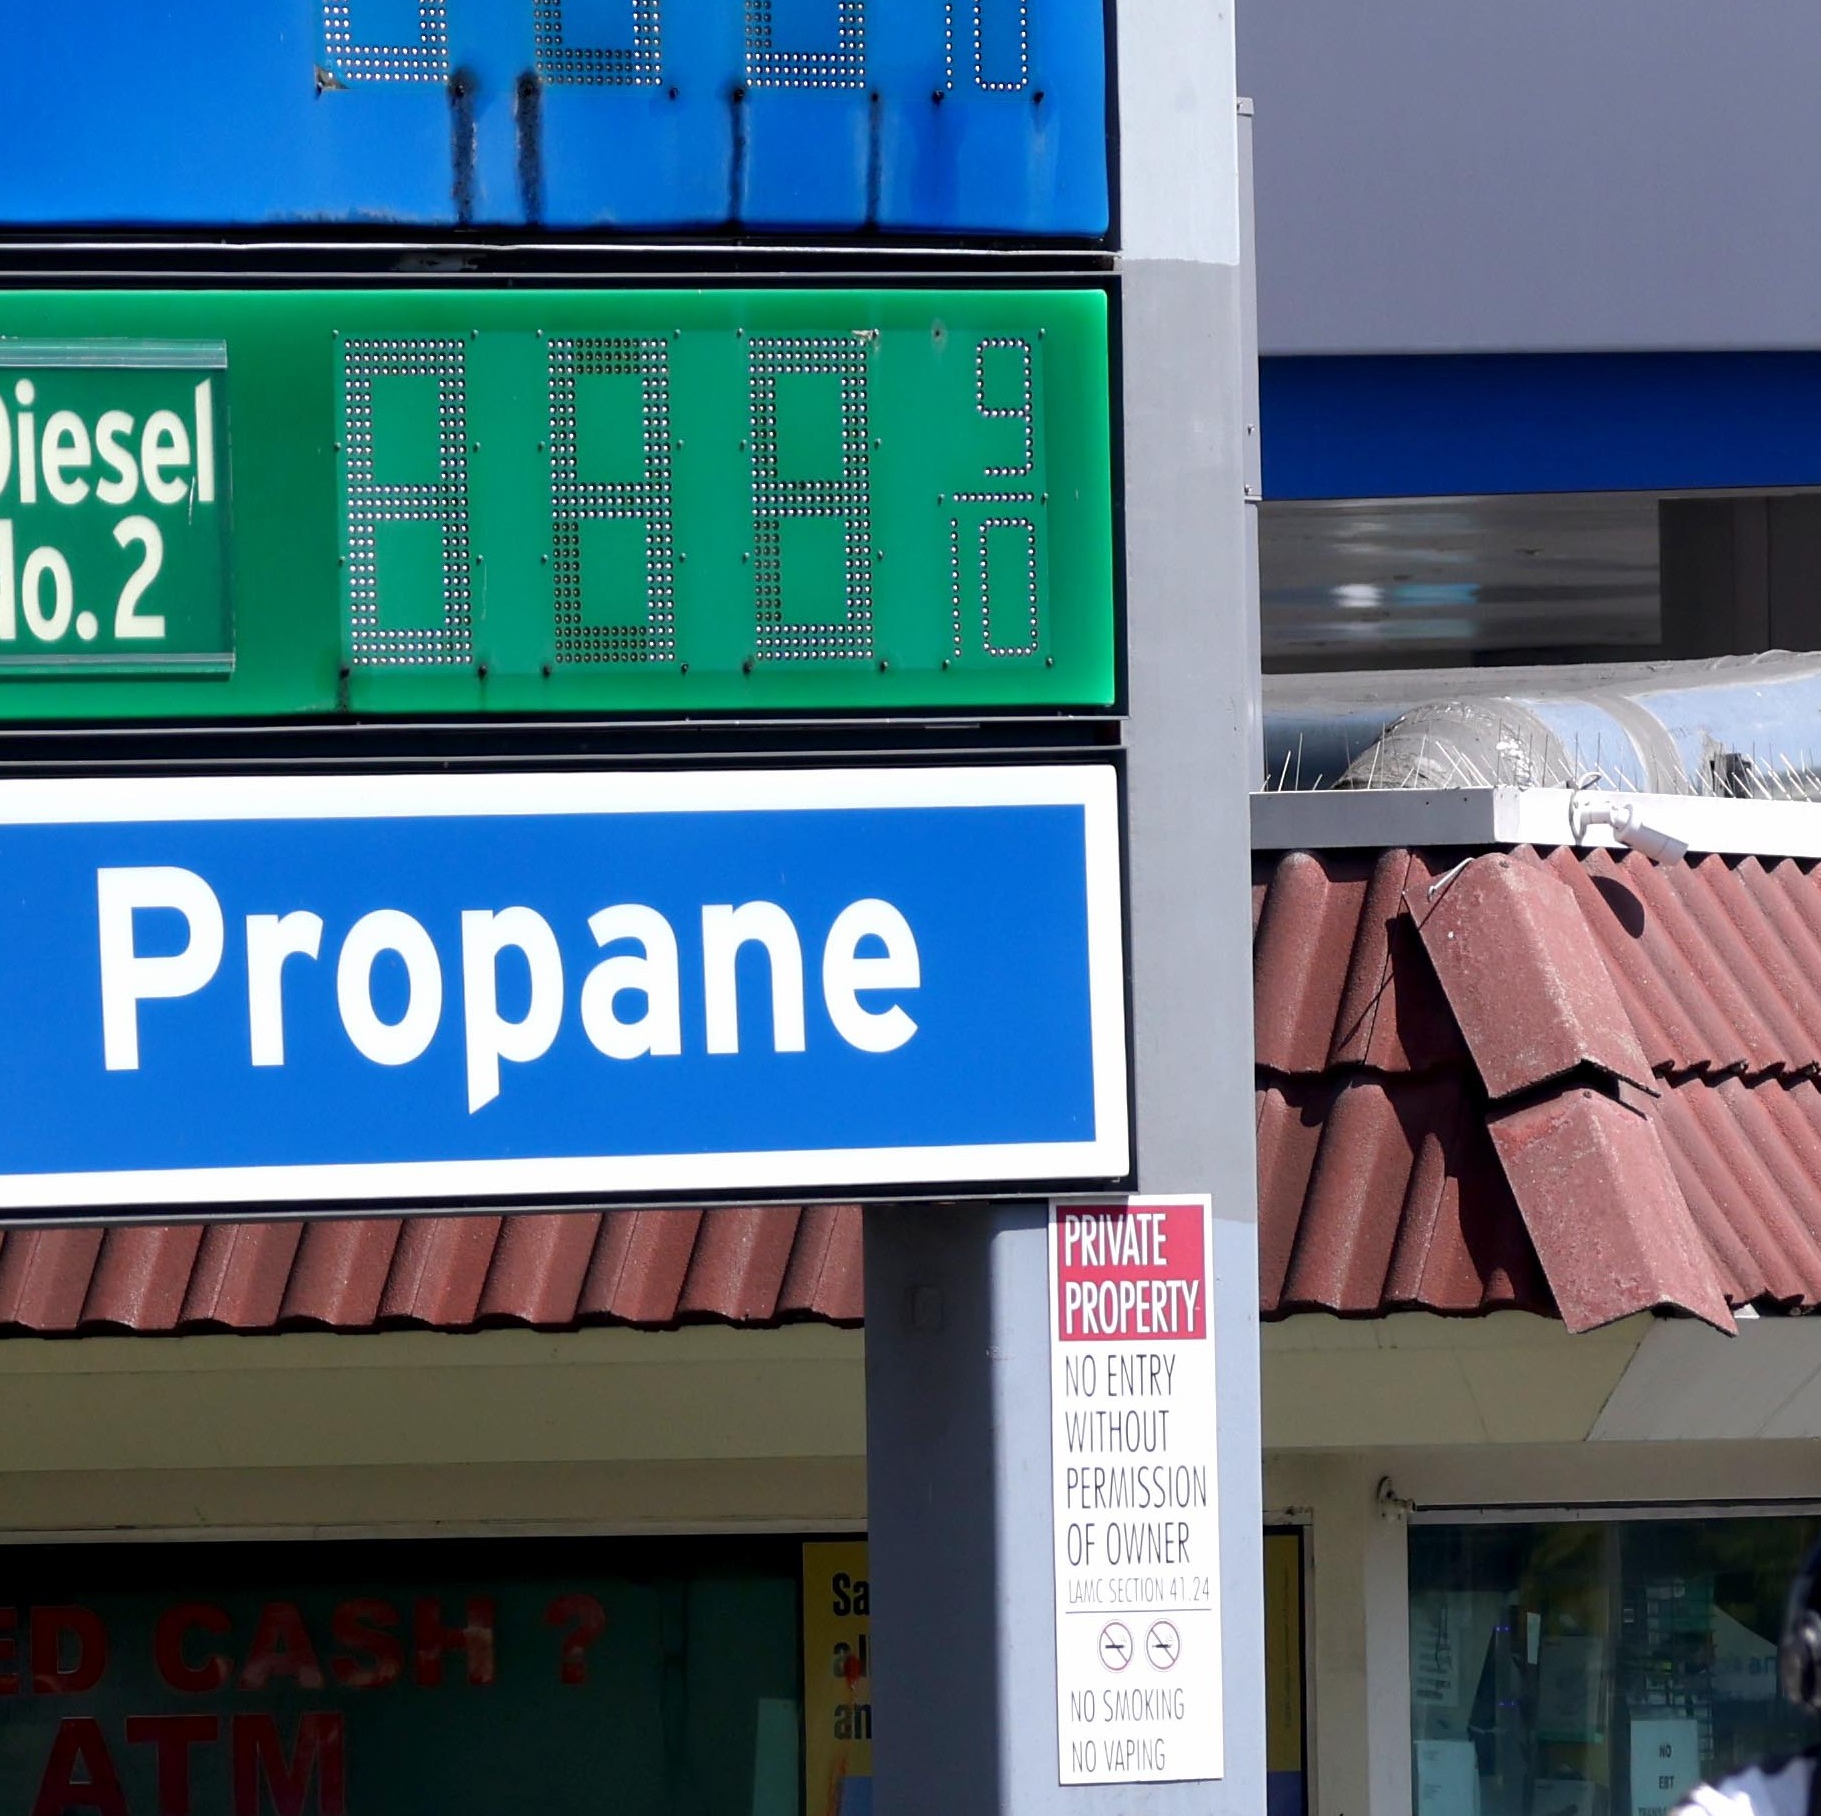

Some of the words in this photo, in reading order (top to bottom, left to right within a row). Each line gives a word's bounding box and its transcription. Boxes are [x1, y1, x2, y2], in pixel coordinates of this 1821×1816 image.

[112, 514, 166, 639] 2
[96, 866, 923, 1118] Propane
[1064, 1211, 1168, 1267] PRIVATE
[1064, 1279, 1200, 1337] PROPERTY
[1065, 1354, 1097, 1399] NO
[1108, 1352, 1177, 1398] ENTRY
[1065, 1409, 1169, 1455] WITHOUT
[1066, 1464, 1208, 1511] PERMISSION
[1067, 1522, 1095, 1567] OF
[1107, 1521, 1191, 1565] OWNER
[1069, 1578, 1104, 1604] LAMC
[1108, 1577, 1164, 1603] SECTION
[1169, 1576, 1210, 1602] 41.24
[153, 1595, 500, 1693] CASH
[542, 1592, 608, 1687] ?
[1071, 1688, 1096, 1723] NO
[1104, 1687, 1185, 1723] SMOKING
[1071, 1740, 1098, 1773] NO
[1107, 1738, 1167, 1772] VAPING
[1659, 1745, 1672, 1759] NO
